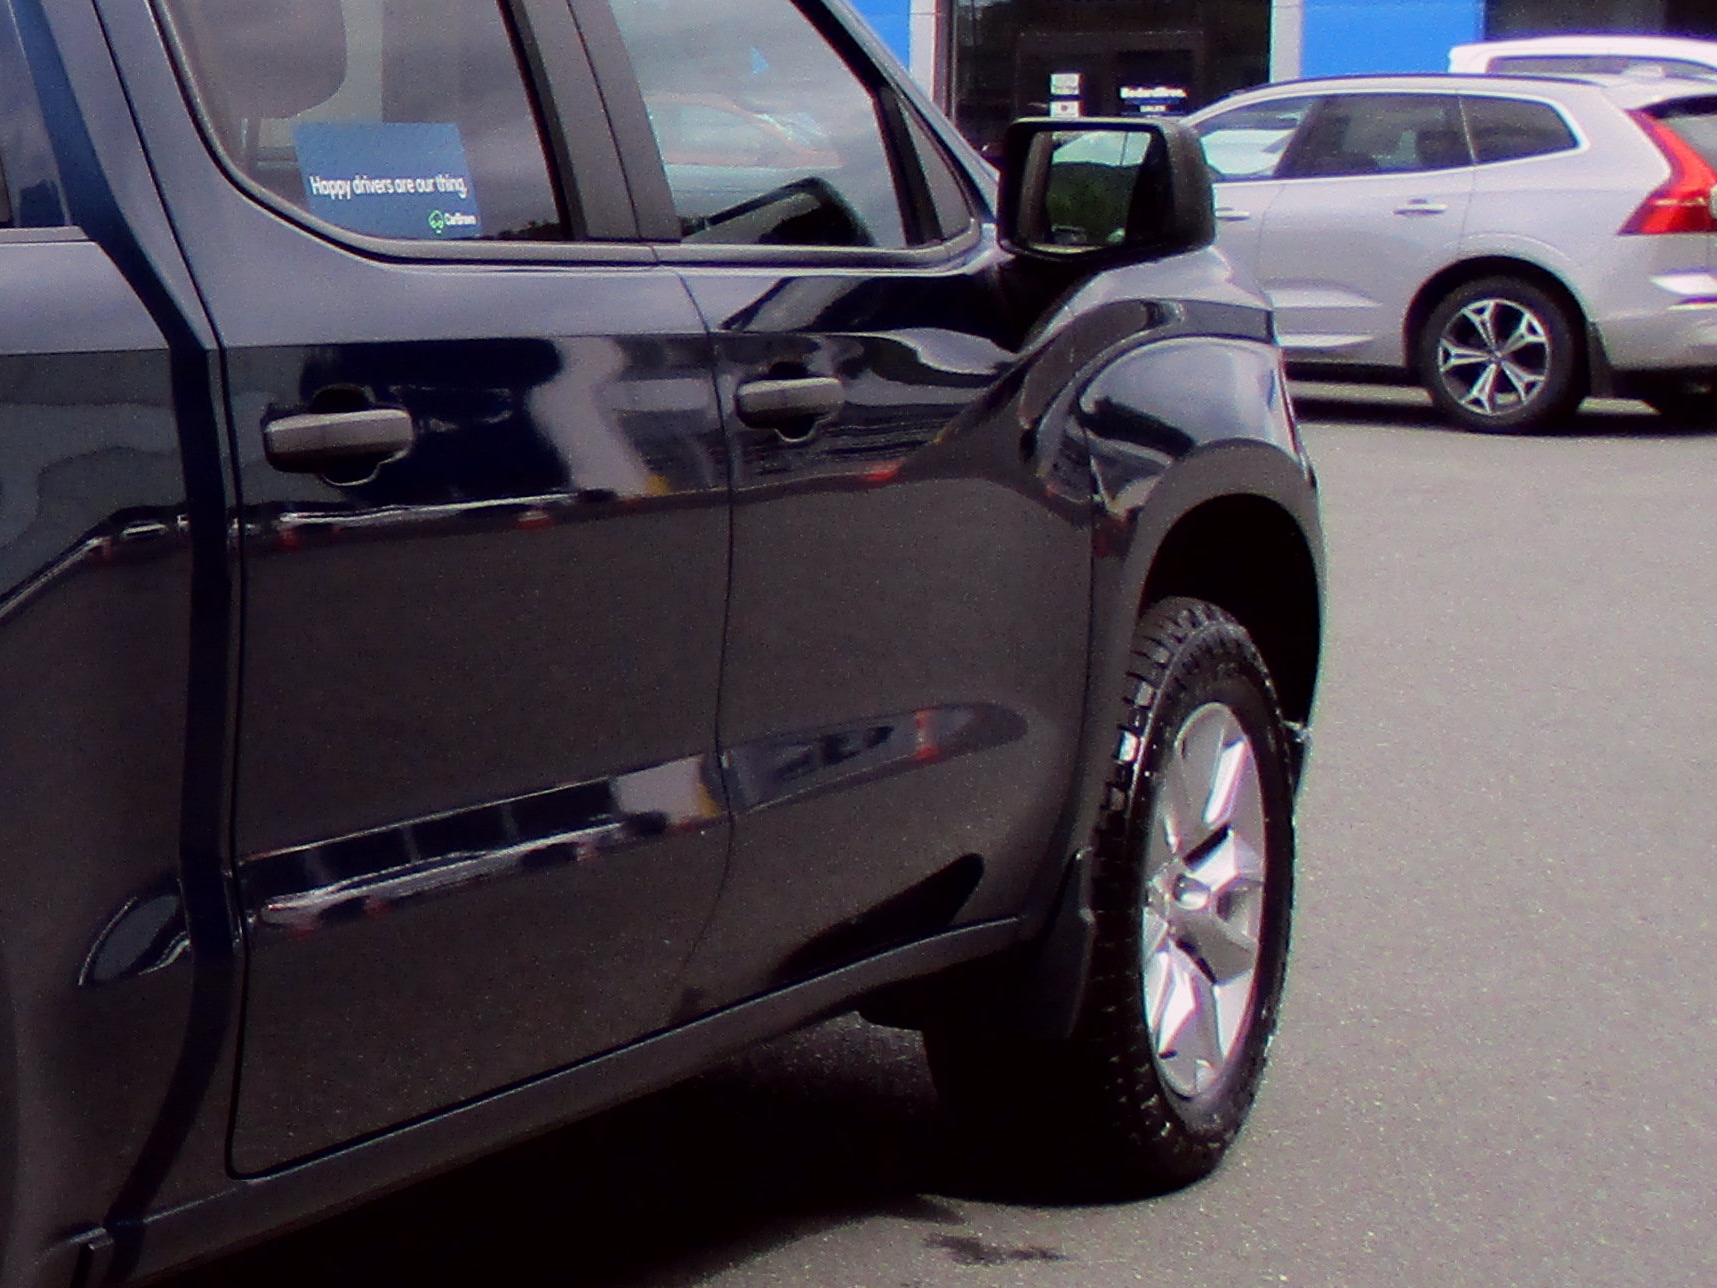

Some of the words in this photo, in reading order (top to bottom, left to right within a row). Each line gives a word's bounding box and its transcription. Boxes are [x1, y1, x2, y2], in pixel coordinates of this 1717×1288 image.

[309, 176, 352, 200] Happy
[352, 175, 394, 195] drivers
[394, 178, 415, 192] are
[415, 177, 435, 192] our
